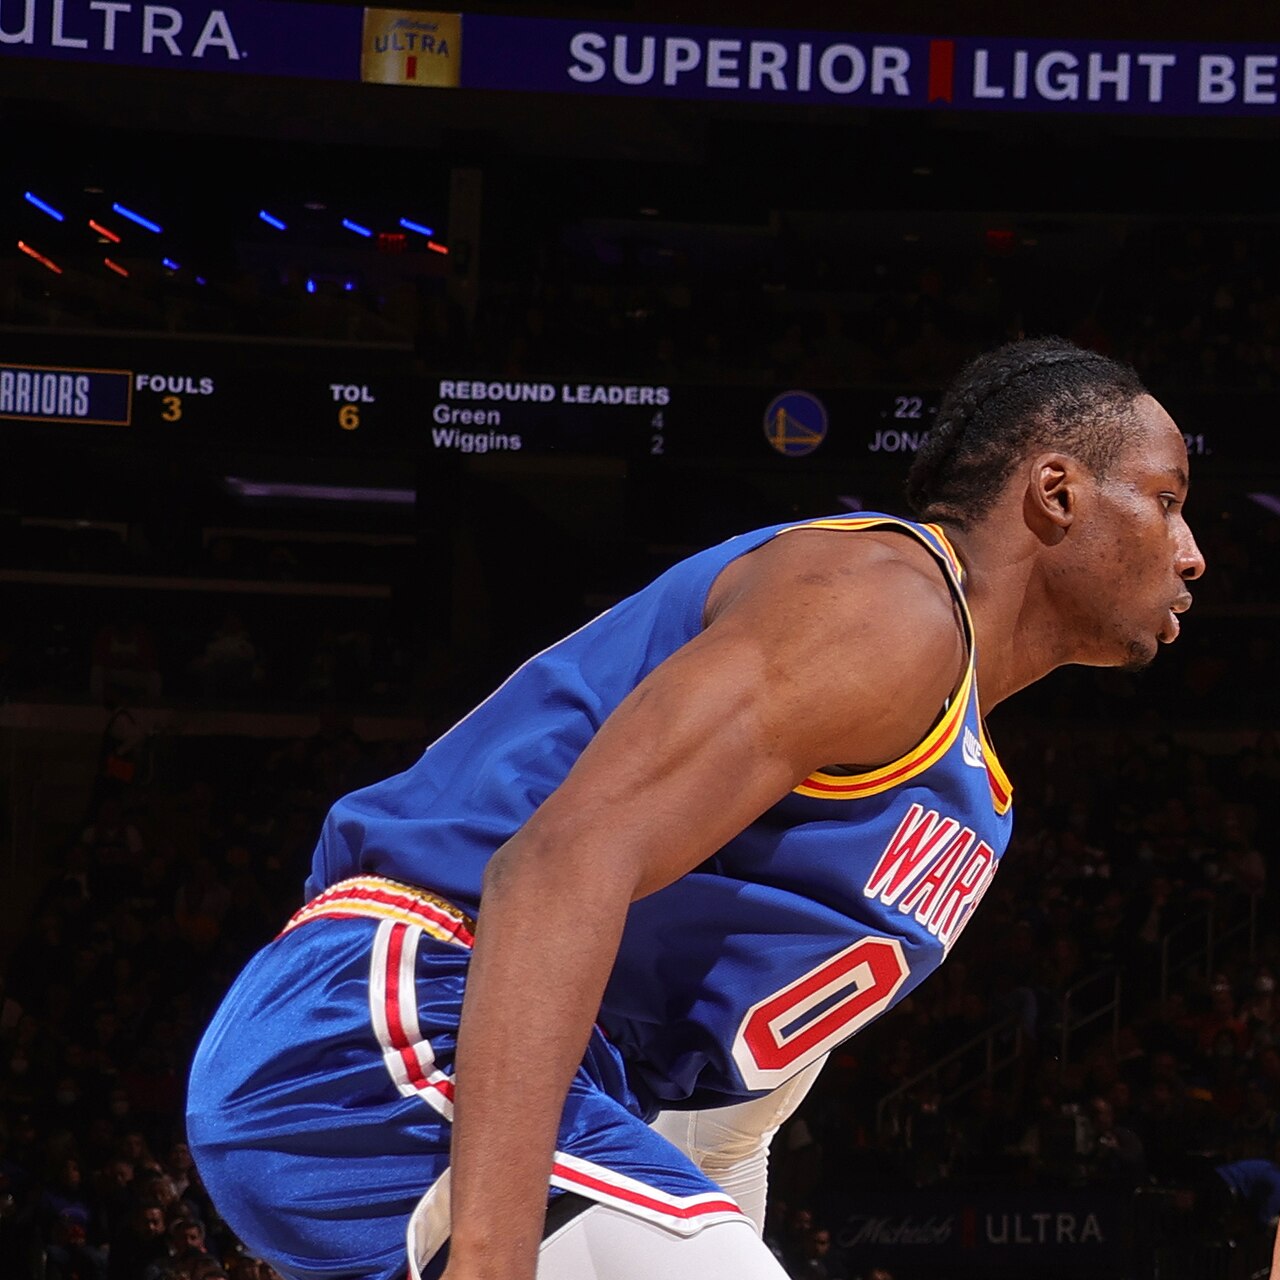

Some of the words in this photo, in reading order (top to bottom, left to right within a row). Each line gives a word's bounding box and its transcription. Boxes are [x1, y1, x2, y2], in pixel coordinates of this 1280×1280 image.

[375, 32, 449, 57] ULTRA
[567, 31, 911, 97] SUPERIOR
[972, 48, 1178, 103] LIGHT
[136, 374, 213, 396] FOULS
[330, 384, 375, 405] TOL
[438, 379, 556, 403] REBOUND
[562, 385, 671, 406] LEADERS
[162, 396, 183, 423] 3
[338, 405, 360, 432] 6
[432, 404, 502, 426] Green
[650, 411, 665, 431] 4
[893, 395, 923, 419] 22
[431, 427, 523, 455] Wiggins
[650, 434, 665, 456] 2
[732, 935, 913, 1091] 0
[837, 1212, 955, 1249] Michelob
[985, 1211, 1105, 1246] ULTRA
